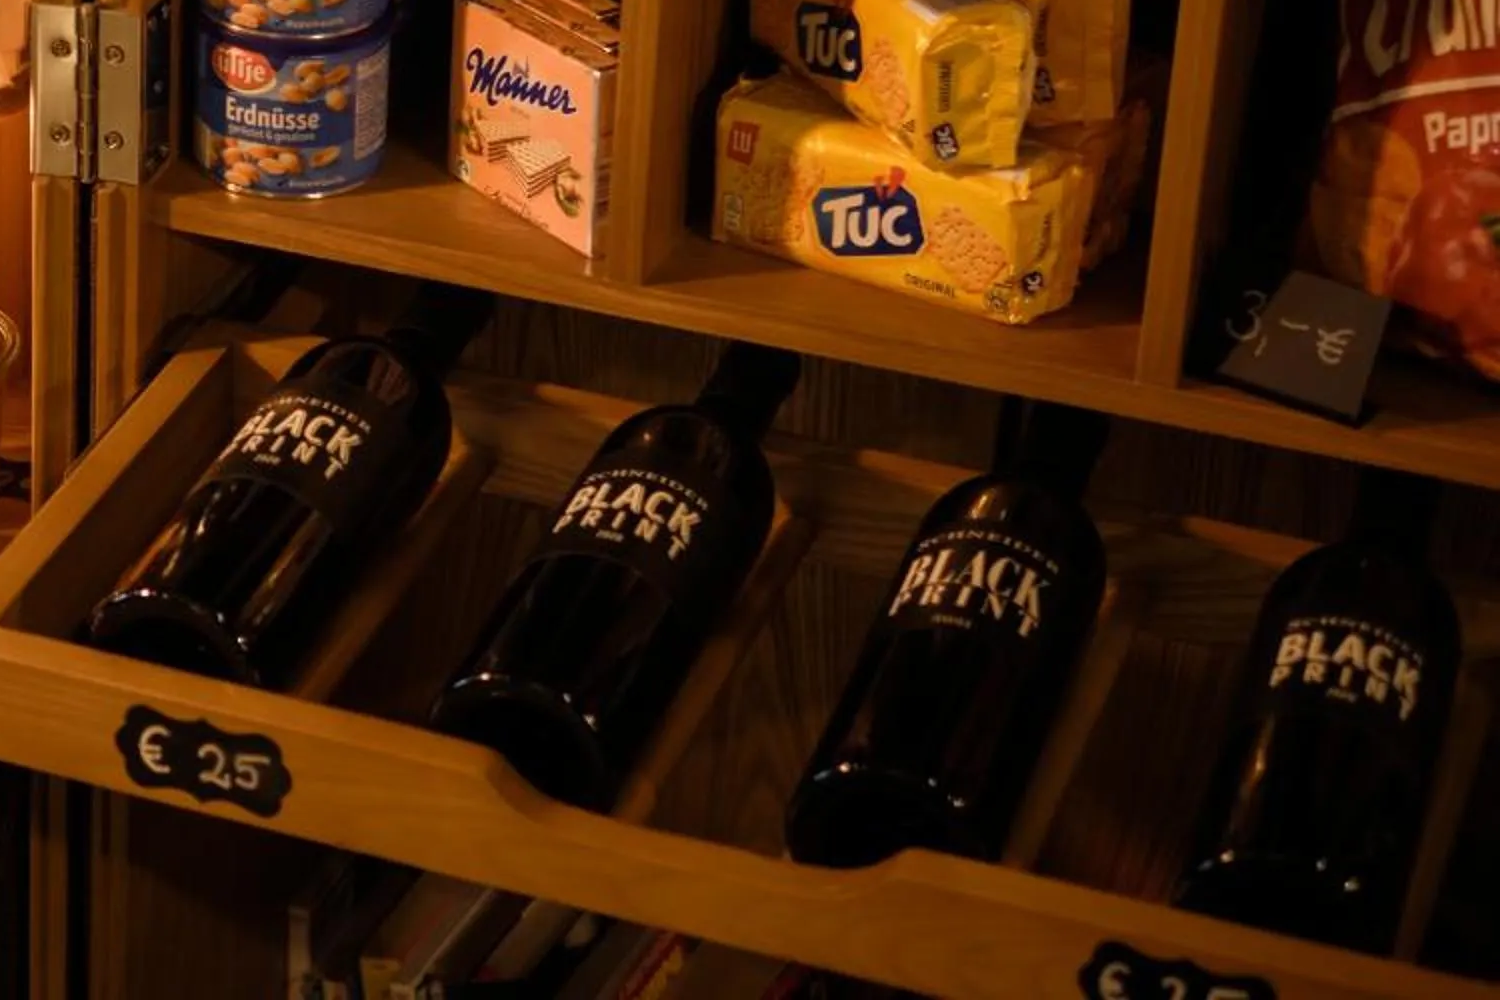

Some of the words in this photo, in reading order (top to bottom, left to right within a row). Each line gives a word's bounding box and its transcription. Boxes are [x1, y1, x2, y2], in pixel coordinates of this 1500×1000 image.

[466, 47, 577, 115] Manner
[225, 95, 321, 131] Erdnüsse
[821, 192, 914, 250] TUC
[234, 408, 364, 466] BLACK
[551, 508, 687, 562] PRINT
[564, 482, 703, 546] BLACK
[887, 583, 1040, 639] PRINT
[898, 547, 1052, 623] BLACK
[1267, 661, 1415, 722] PRINT
[1275, 629, 1422, 699] BLACK
[138, 724, 172, 774] €
[197, 743, 272, 791] 25
